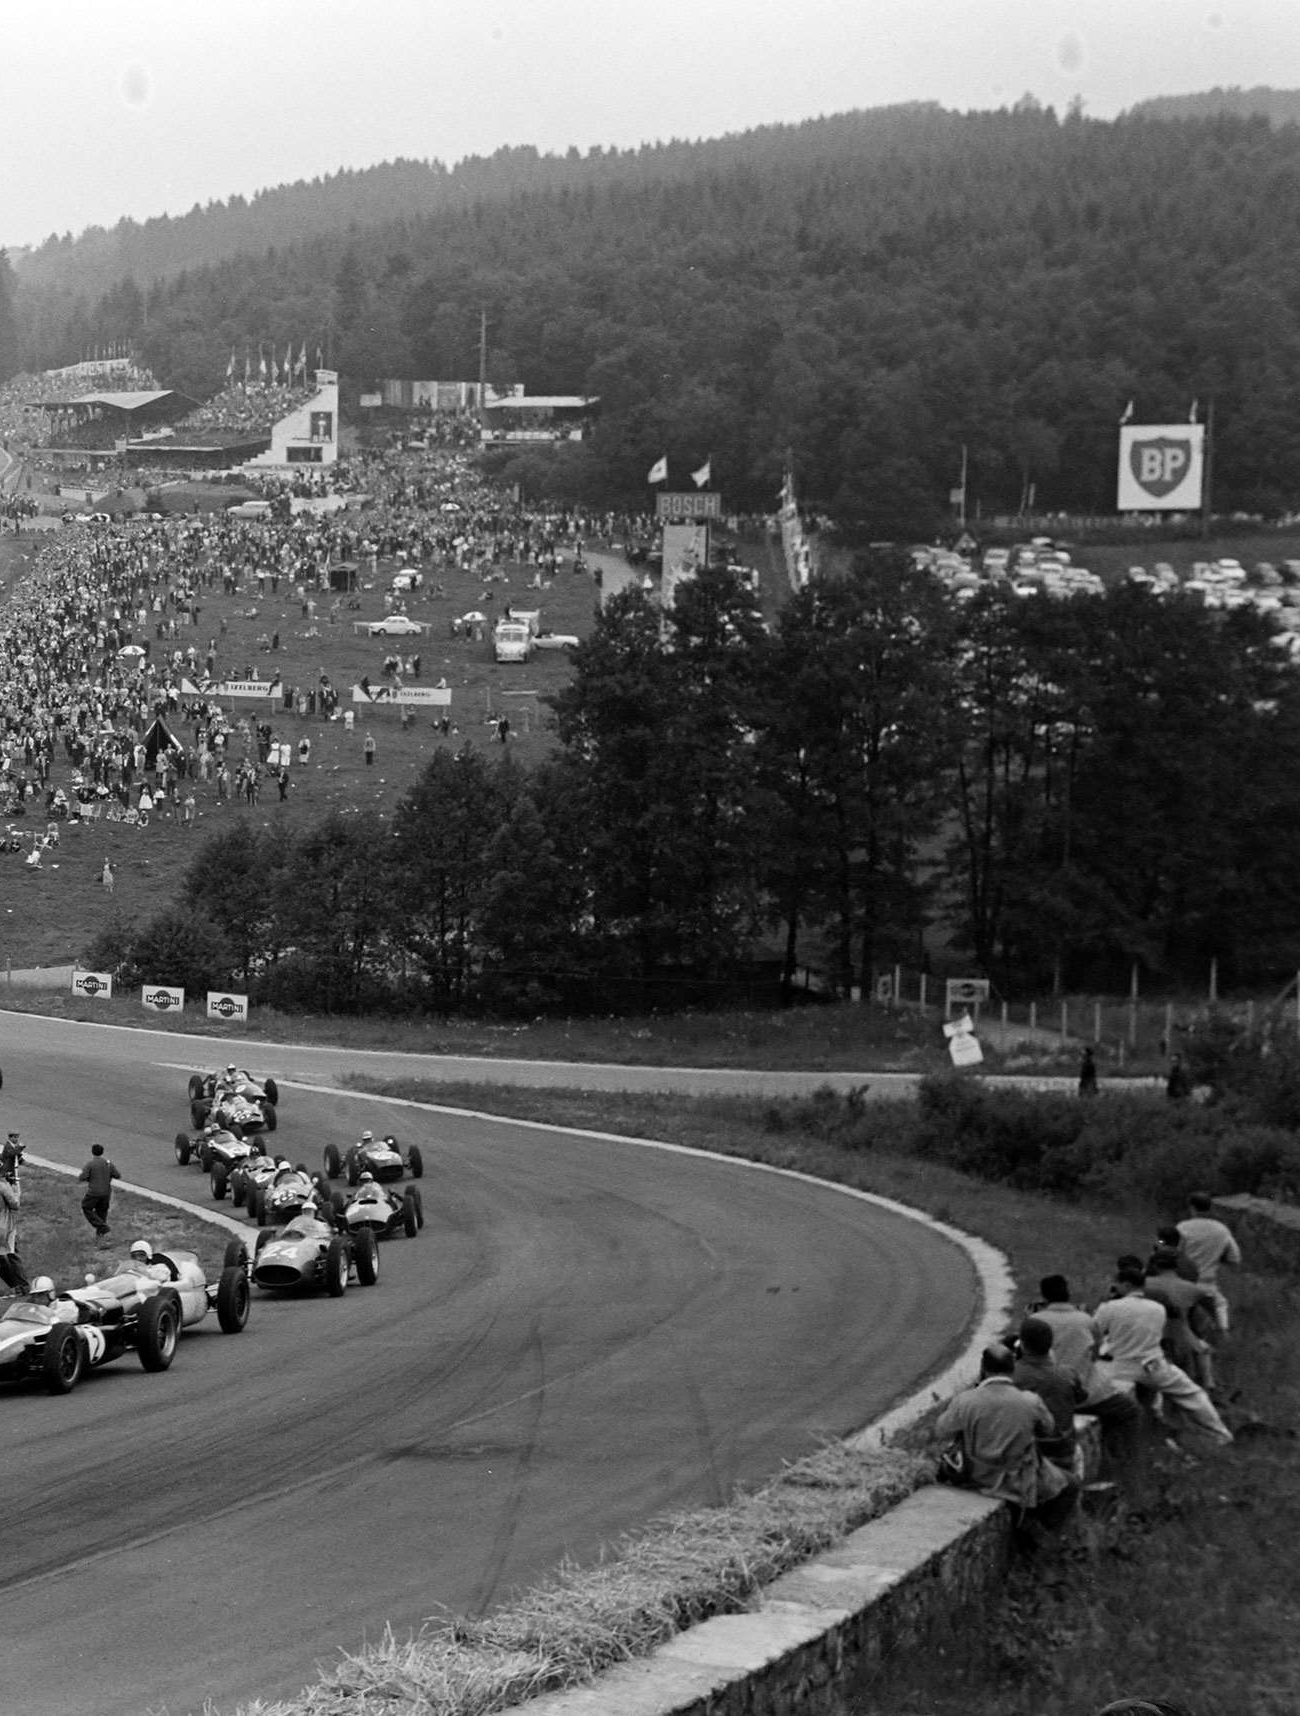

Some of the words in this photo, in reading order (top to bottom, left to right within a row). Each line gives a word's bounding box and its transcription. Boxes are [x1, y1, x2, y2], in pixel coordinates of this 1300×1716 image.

[1141, 448, 1185, 481] BP
[661, 495, 716, 516] BOSCH
[77, 980, 107, 990] MARTINI
[147, 995, 179, 1005] MARTINI
[212, 1002, 243, 1013] MARTINI
[261, 1246, 299, 1260] 24
